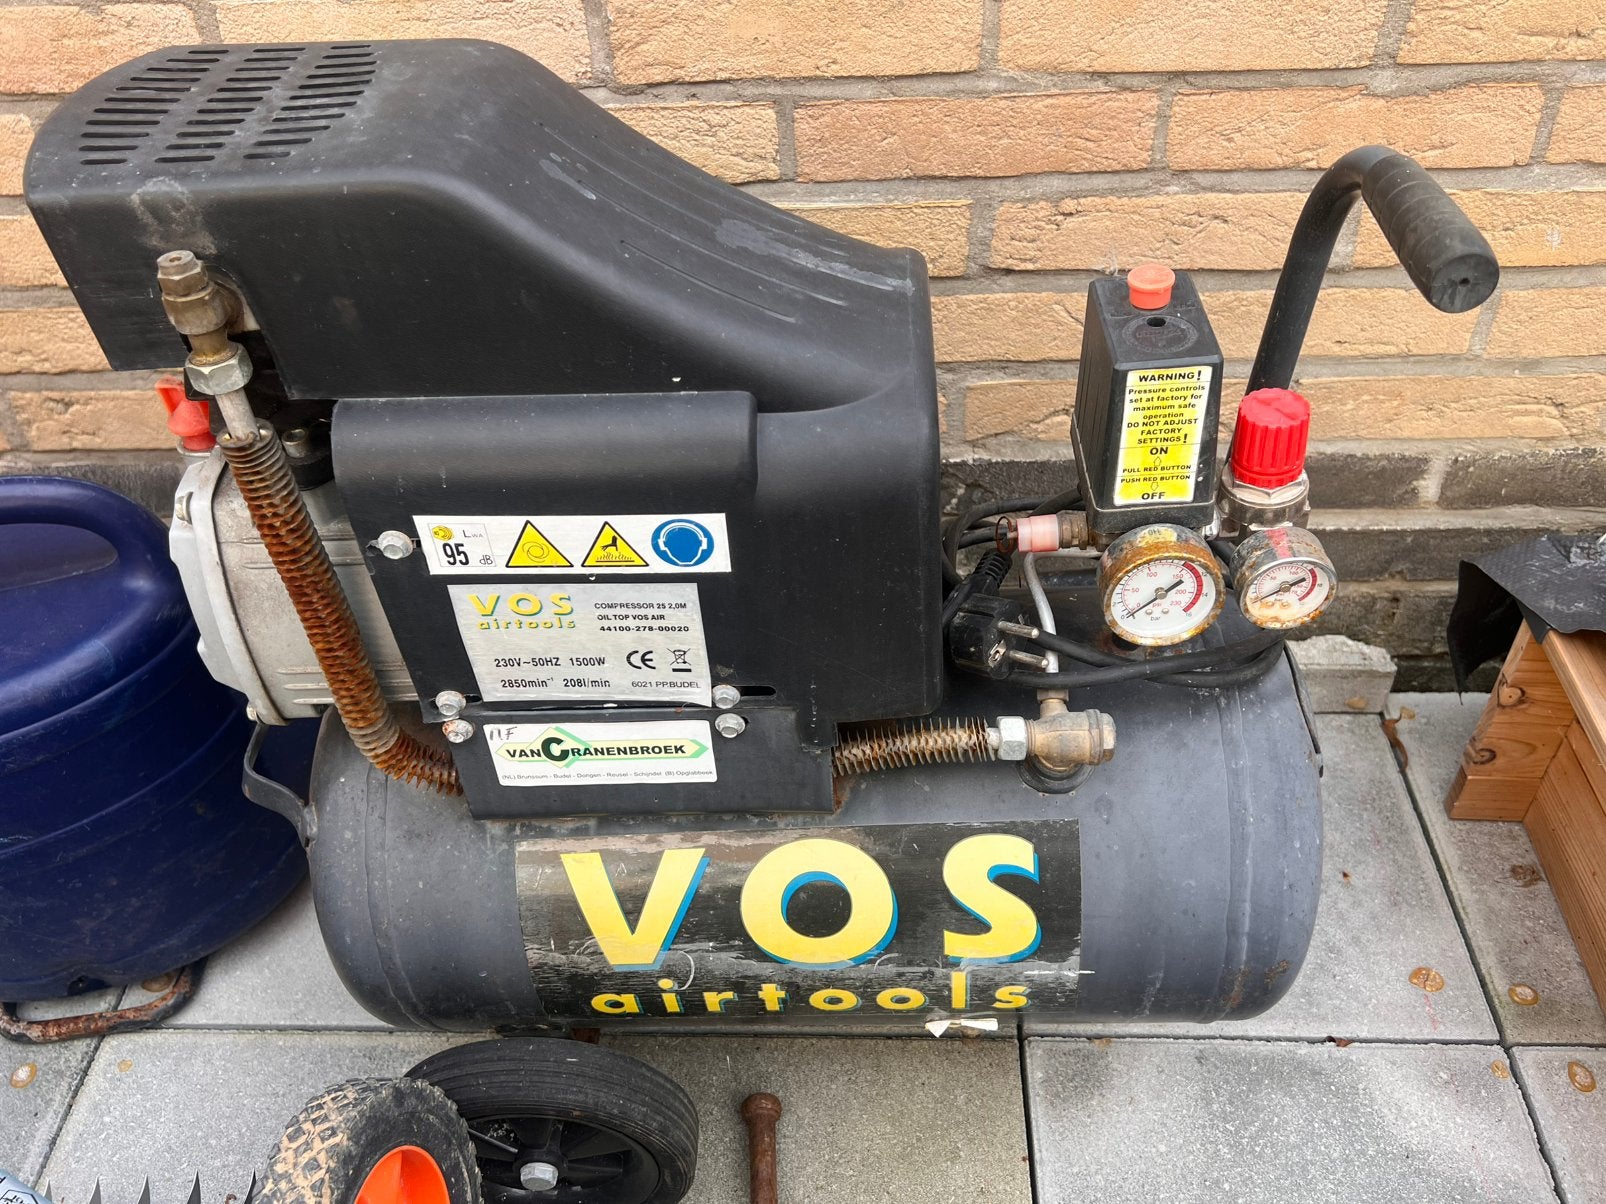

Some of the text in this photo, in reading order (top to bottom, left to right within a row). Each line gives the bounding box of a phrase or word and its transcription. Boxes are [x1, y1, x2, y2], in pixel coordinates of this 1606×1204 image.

[1169, 384, 1205, 392] controls
[1157, 394, 1188, 402] factory
[1133, 404, 1175, 412] maximum
[1143, 412, 1184, 420] operation
[1163, 418, 1198, 426] ADJUST
[1140, 427, 1183, 436] FACTORY
[1149, 446, 1169, 455] ON
[1141, 491, 1166, 500] OFF
[442, 542, 493, 566] 95 dB
[467, 592, 574, 616] VOS
[667, 602, 687, 610] 2,0M
[476, 616, 576, 630] airtools
[494, 657, 606, 668] 230V~50HZ 1500W
[560, 833, 1042, 971] VOS
[591, 970, 1031, 1015] airtools
